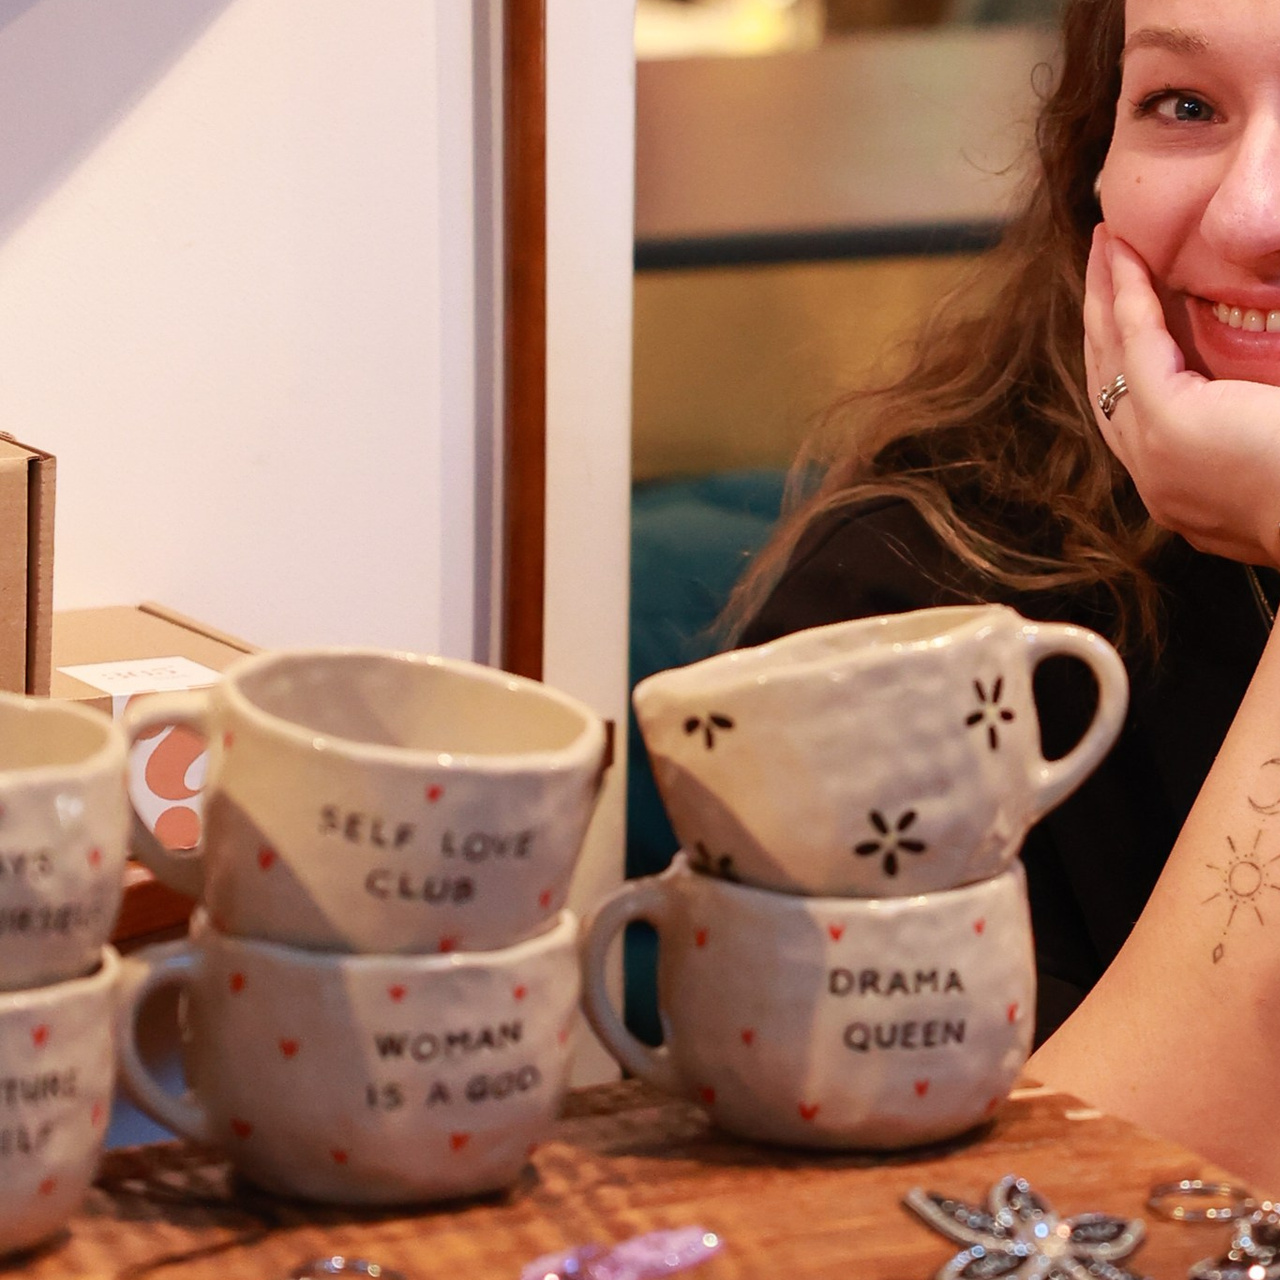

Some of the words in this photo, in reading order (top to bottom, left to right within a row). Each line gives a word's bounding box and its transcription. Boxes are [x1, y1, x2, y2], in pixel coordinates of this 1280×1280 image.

[318, 804, 416, 848] SELF
[442, 828, 536, 863] LOVE
[364, 869, 475, 904] CLUB
[829, 968, 964, 998] DRAMA
[375, 1021, 523, 1063] WOMAN
[843, 1019, 966, 1053] QUEEN
[366, 1080, 403, 1111] IS
[425, 1079, 450, 1107] A
